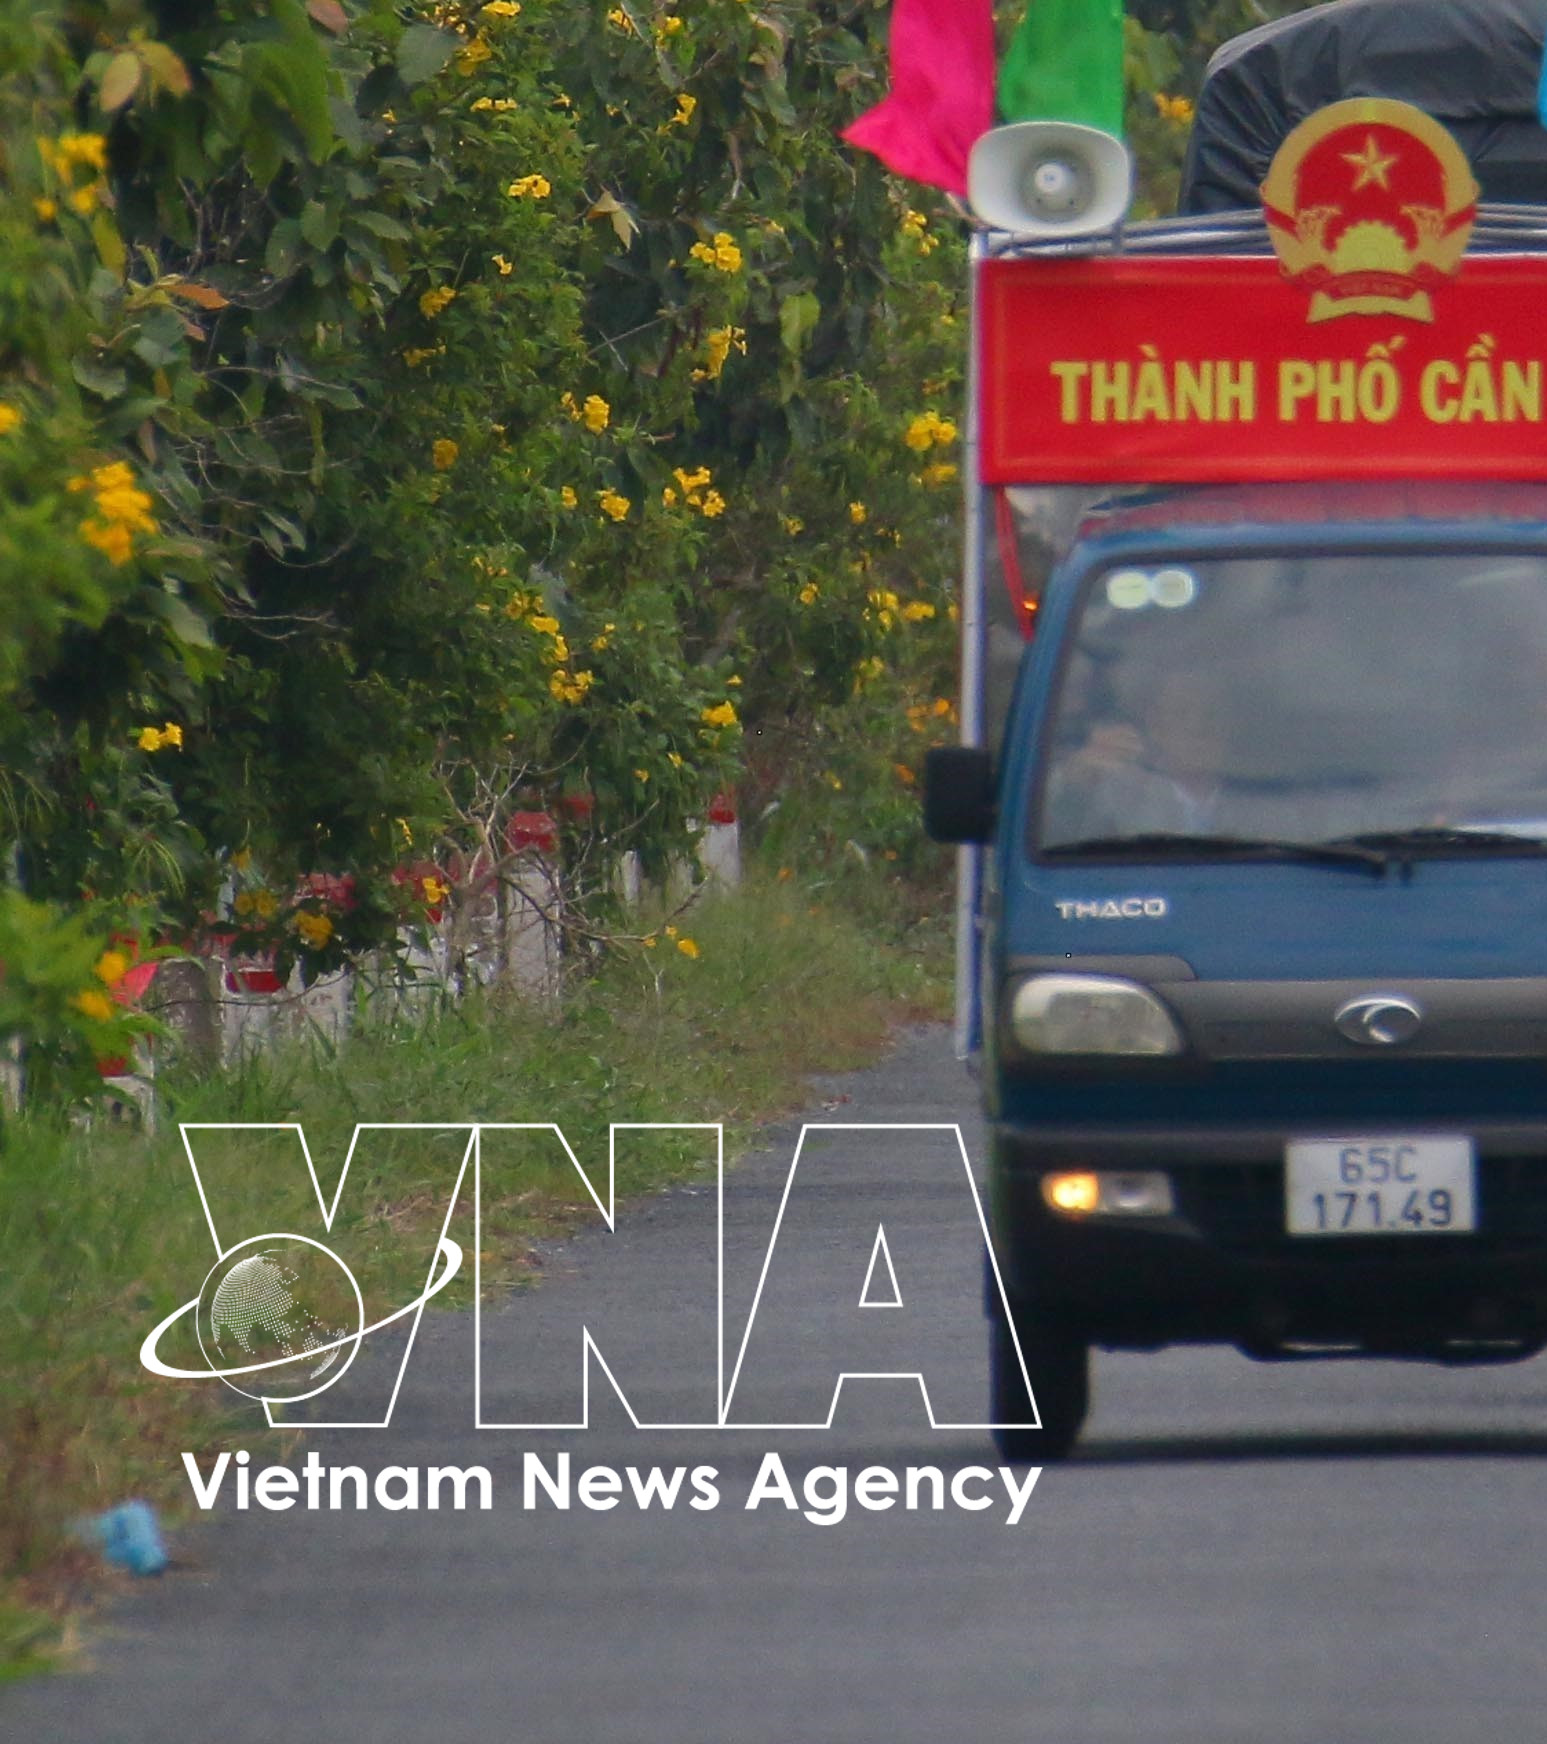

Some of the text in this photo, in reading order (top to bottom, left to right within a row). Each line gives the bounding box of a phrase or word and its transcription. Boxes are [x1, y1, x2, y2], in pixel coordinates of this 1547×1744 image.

[1050, 344, 1256, 423] THÀNH
[1278, 335, 1405, 424] PHỐ
[1420, 333, 1542, 424] CẦN
[1055, 896, 1168, 920] THACO
[1339, 1147, 1417, 1184] 65C
[1312, 1188, 1454, 1229] 171.49
